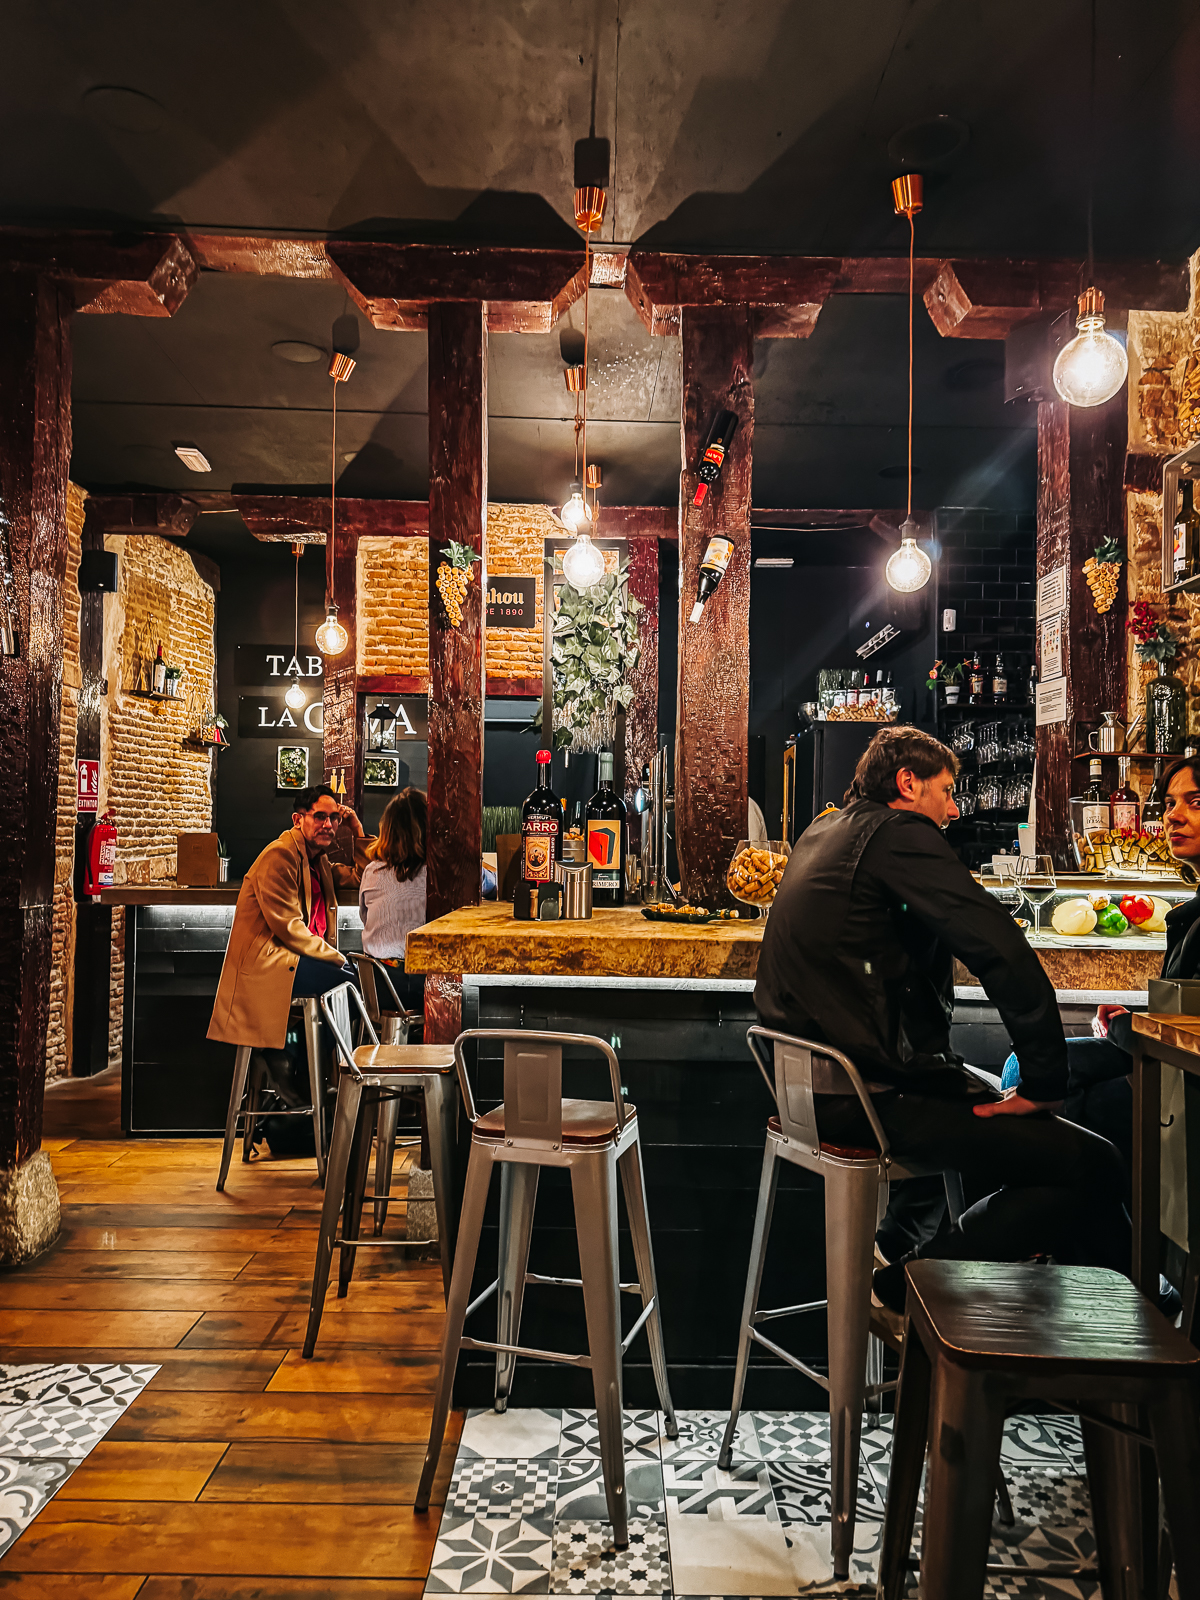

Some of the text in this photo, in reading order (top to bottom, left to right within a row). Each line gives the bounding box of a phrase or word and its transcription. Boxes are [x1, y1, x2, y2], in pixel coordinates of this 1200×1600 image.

[707, 453, 721, 461] LAN
[500, 608, 523, 616] 1890
[266, 655, 323, 677] TAB
[258, 706, 297, 727] LA
[79, 799, 97, 807] EXTINTOR
[521, 822, 558, 832] ZARRO
